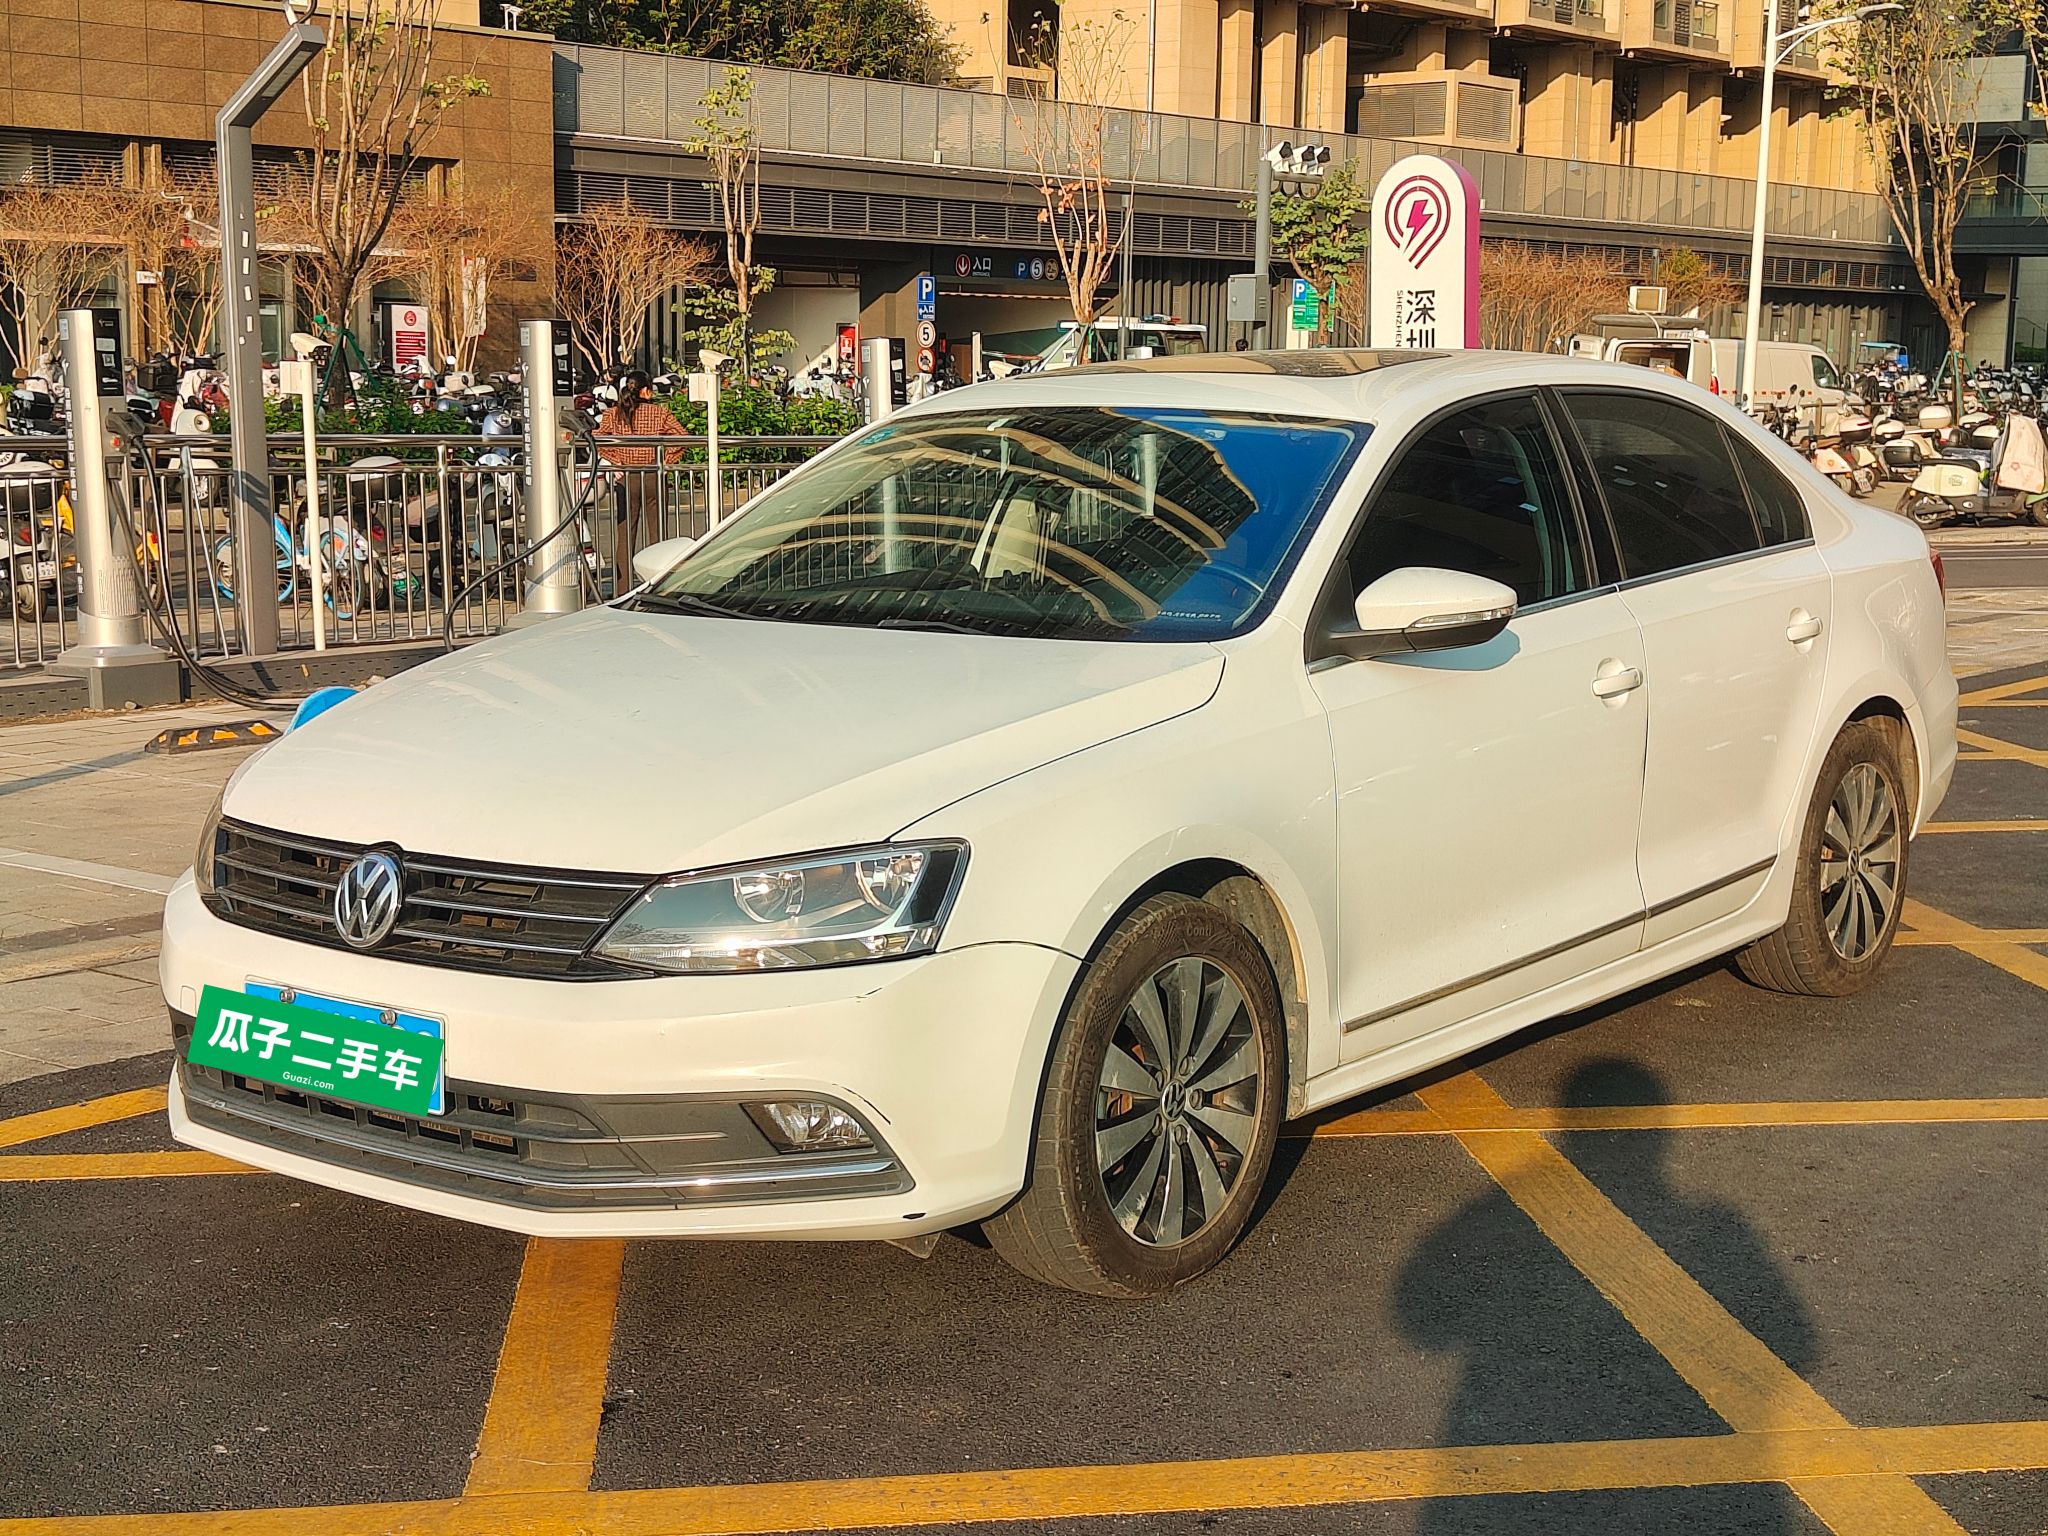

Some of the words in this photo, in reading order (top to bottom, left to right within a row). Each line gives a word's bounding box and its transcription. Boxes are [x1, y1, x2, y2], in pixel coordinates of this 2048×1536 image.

[972, 256, 991, 271] 入口
[1018, 262, 1026, 276] P
[1033, 260, 1040, 275] 5
[922, 279, 933, 300] P
[1295, 282, 1305, 298] P
[922, 304, 934, 314] 入口
[1395, 289, 1404, 347] SHENZHEN
[1405, 289, 1436, 348] 深圳
[922, 326, 930, 342] 5
